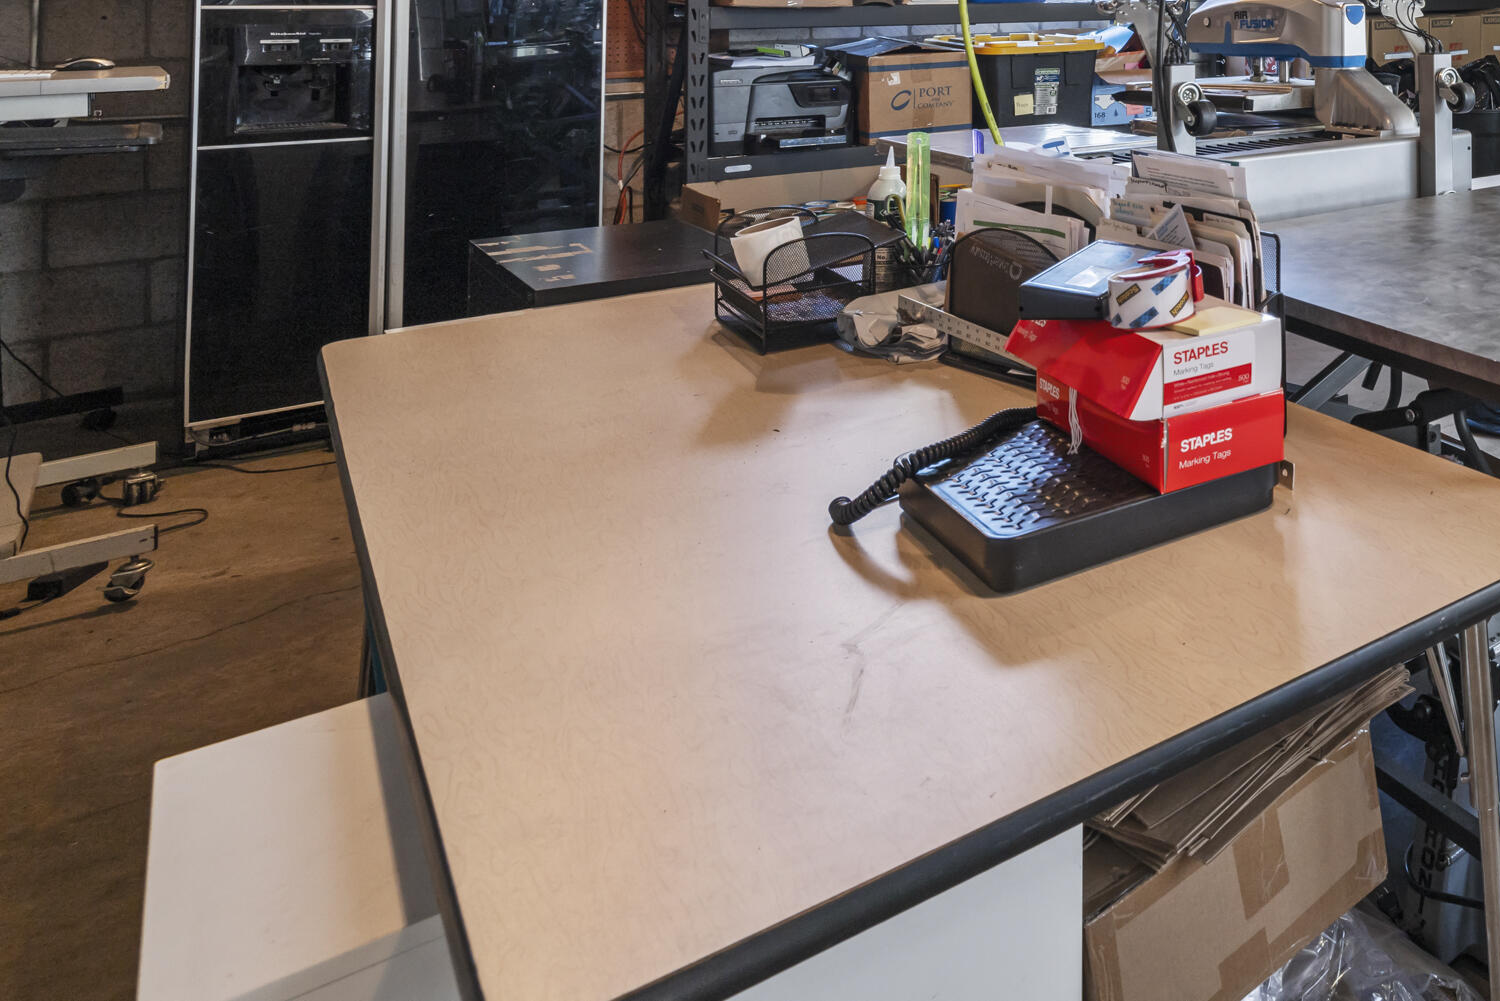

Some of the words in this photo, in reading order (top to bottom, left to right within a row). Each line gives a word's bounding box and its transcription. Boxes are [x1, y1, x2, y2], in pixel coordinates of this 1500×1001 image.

[1234, 10, 1248, 19] AIR
[1239, 18, 1275, 29] FUSION
[919, 85, 953, 98] PORT
[1173, 341, 1229, 365] STAPLES
[1173, 365, 1198, 376] Marking
[1200, 361, 1215, 370] Tags
[1039, 377, 1060, 400] STAPLES
[1180, 428, 1233, 453] STAPLES
[1178, 454, 1211, 470] Marking
[1213, 449, 1232, 460] Tags
